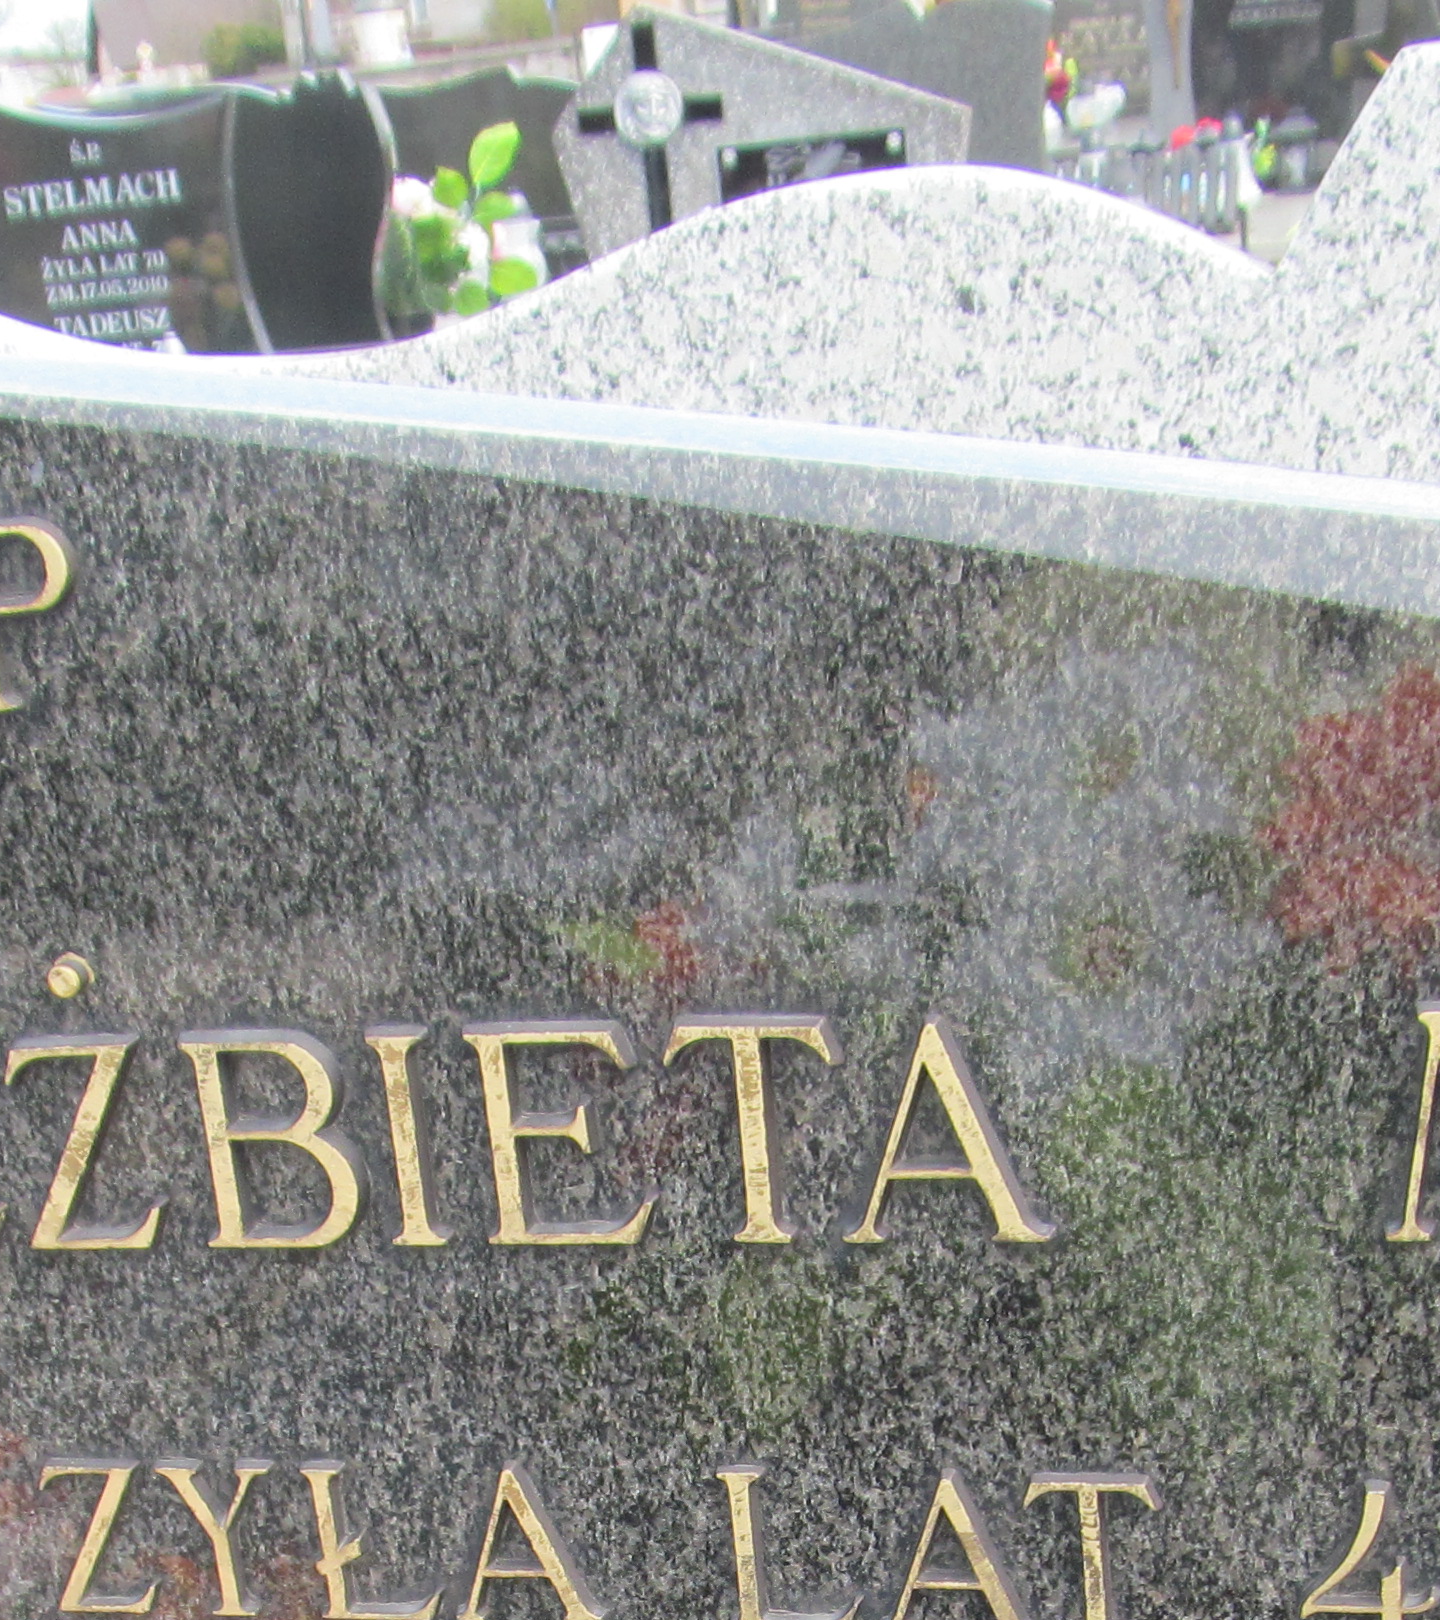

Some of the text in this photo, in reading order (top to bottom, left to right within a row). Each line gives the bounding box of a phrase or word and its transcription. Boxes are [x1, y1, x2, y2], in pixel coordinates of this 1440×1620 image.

[3, 168, 181, 217] STELMACH
[61, 219, 138, 251] ANNA
[100, 252, 140, 274] LAT
[54, 306, 171, 337] TADEUSZ
